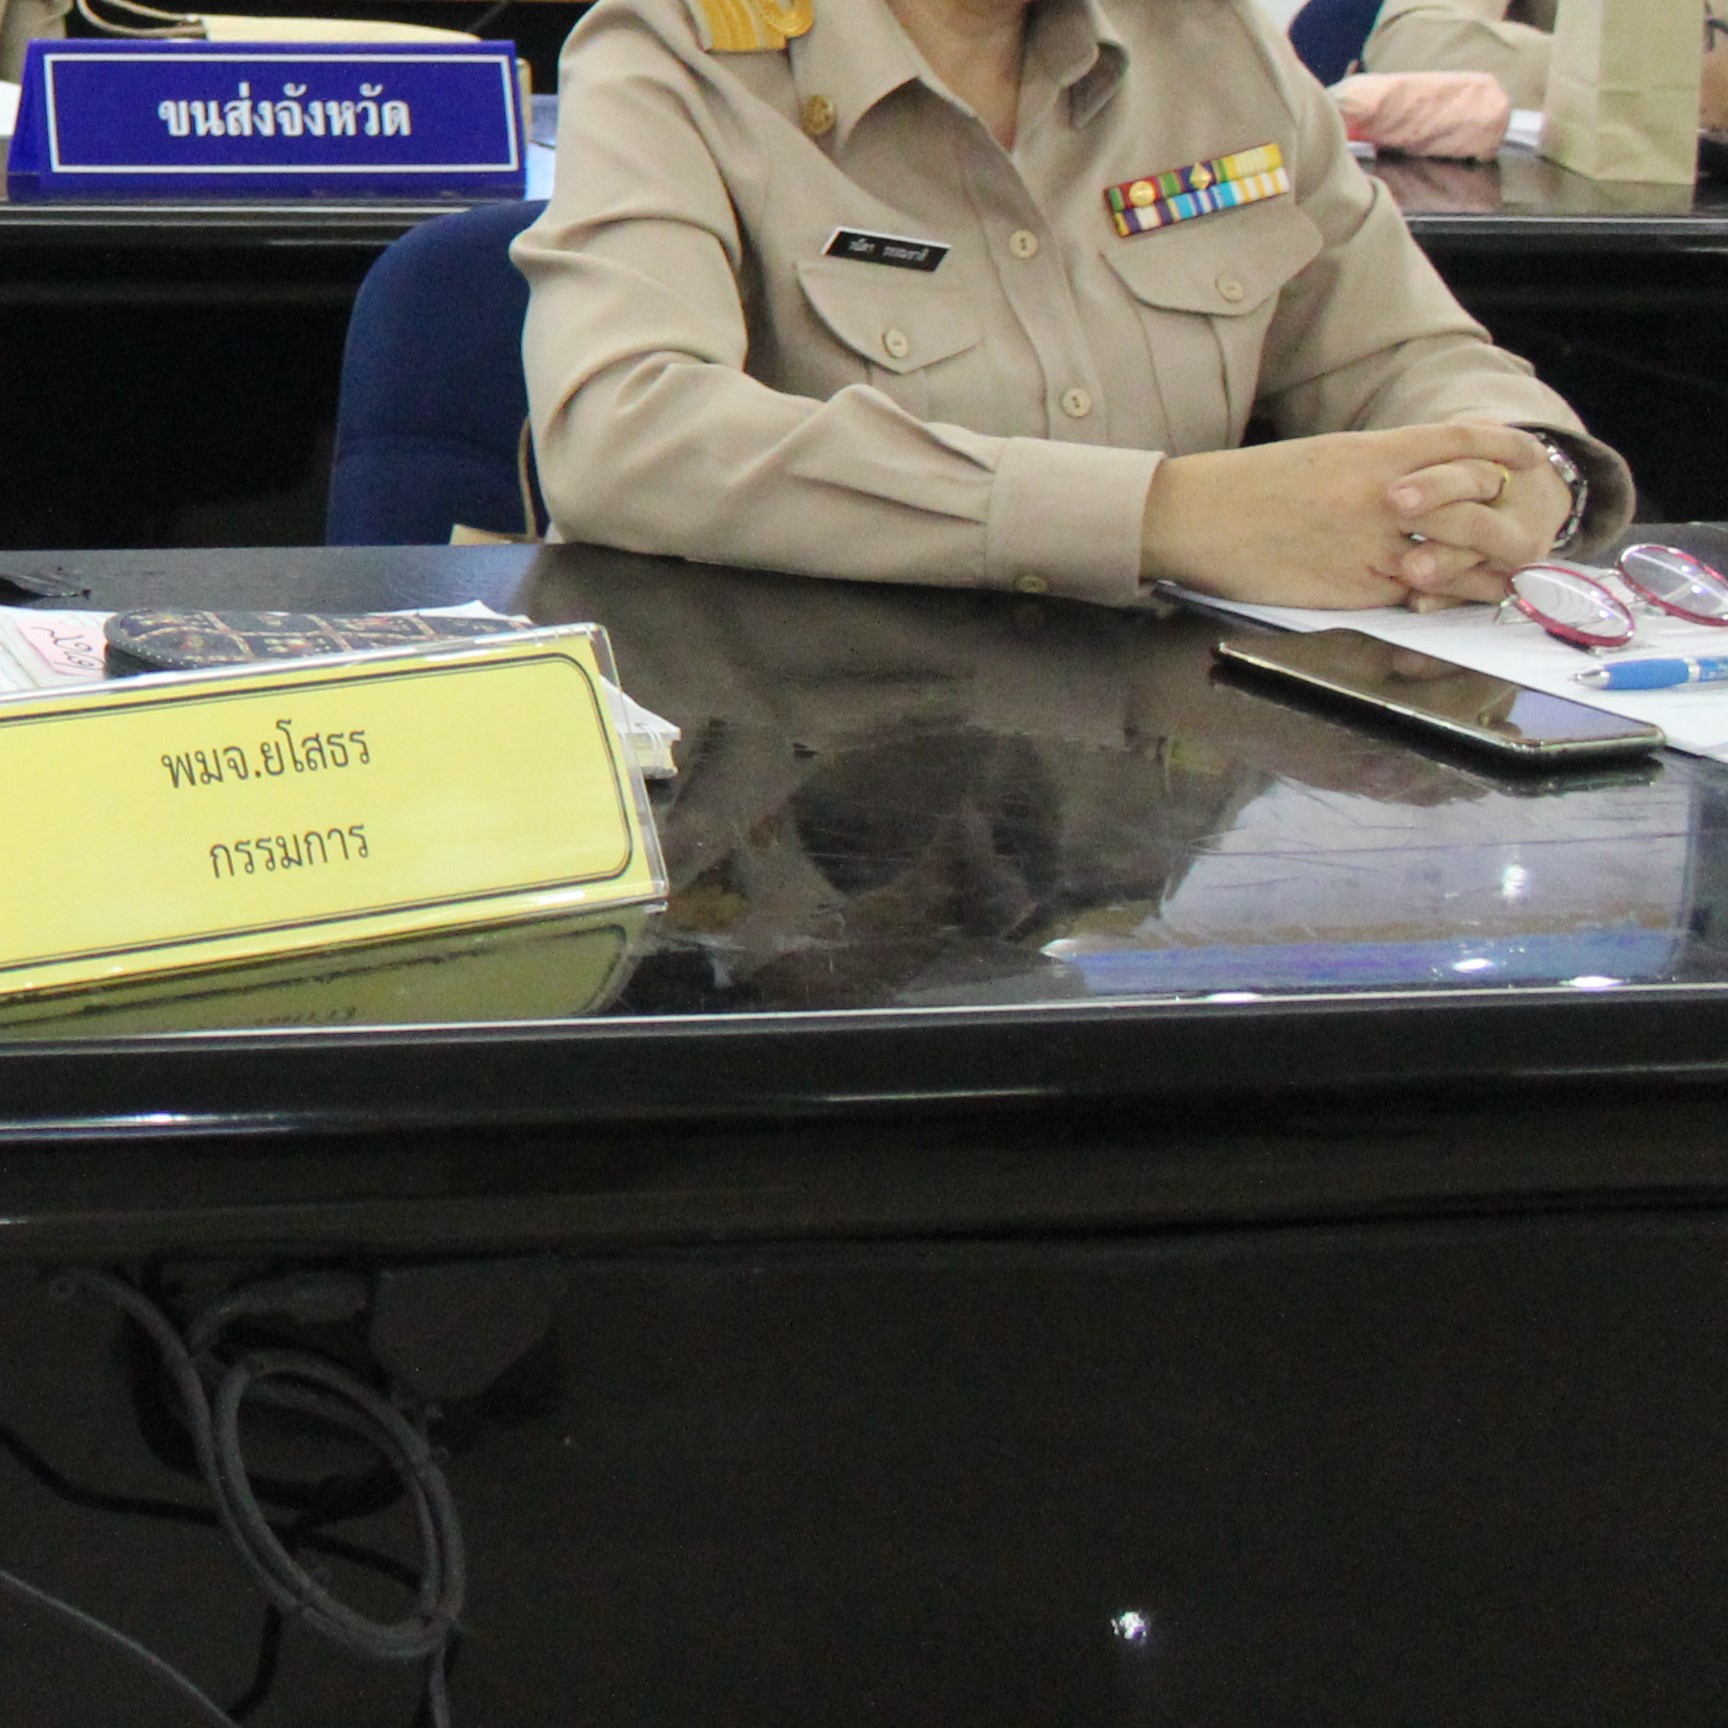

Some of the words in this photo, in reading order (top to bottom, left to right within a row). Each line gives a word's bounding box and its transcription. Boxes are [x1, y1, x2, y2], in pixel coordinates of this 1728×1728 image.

[157, 81, 412, 138] ขนส่งจังหวัด
[160, 718, 371, 789] พมจ.ยโสธร
[209, 824, 370, 879] กรรมการ
